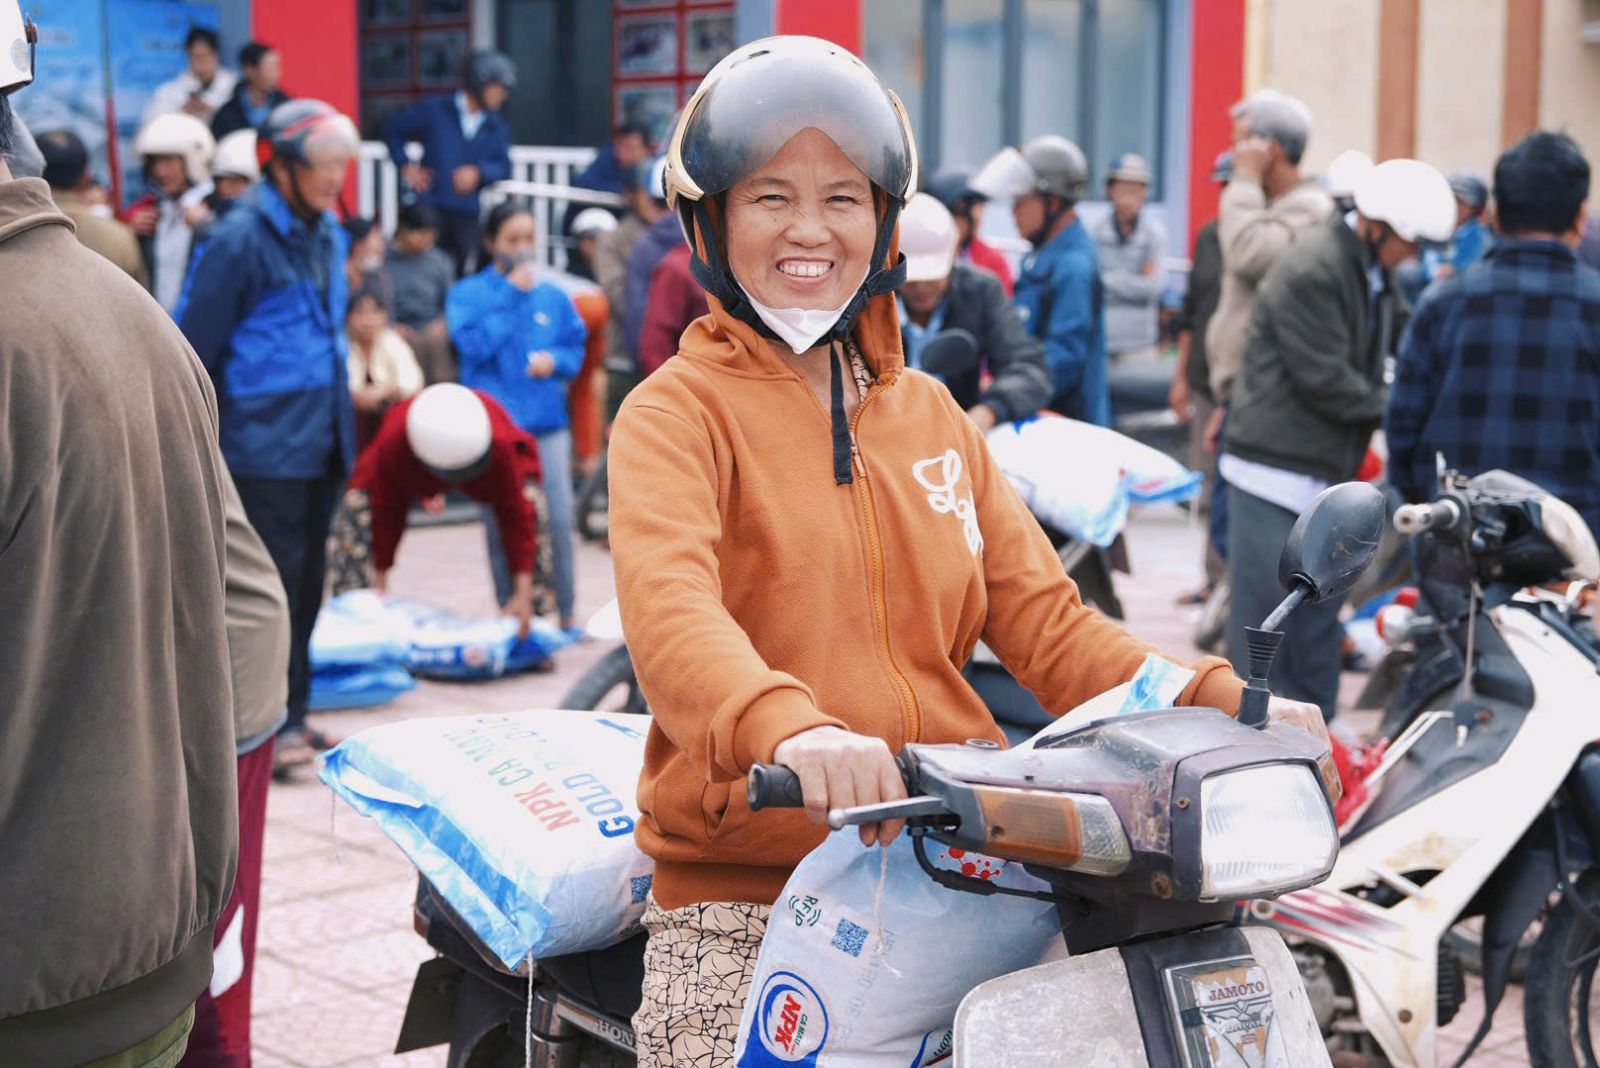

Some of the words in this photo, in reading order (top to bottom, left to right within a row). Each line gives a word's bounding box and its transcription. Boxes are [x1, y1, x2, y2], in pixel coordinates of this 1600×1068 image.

[514, 782, 581, 832] NPK
[563, 773, 635, 838] GOLD
[794, 895, 819, 927] RFID
[1209, 981, 1265, 1002] JAMOTO
[774, 994, 801, 1055] NPK
